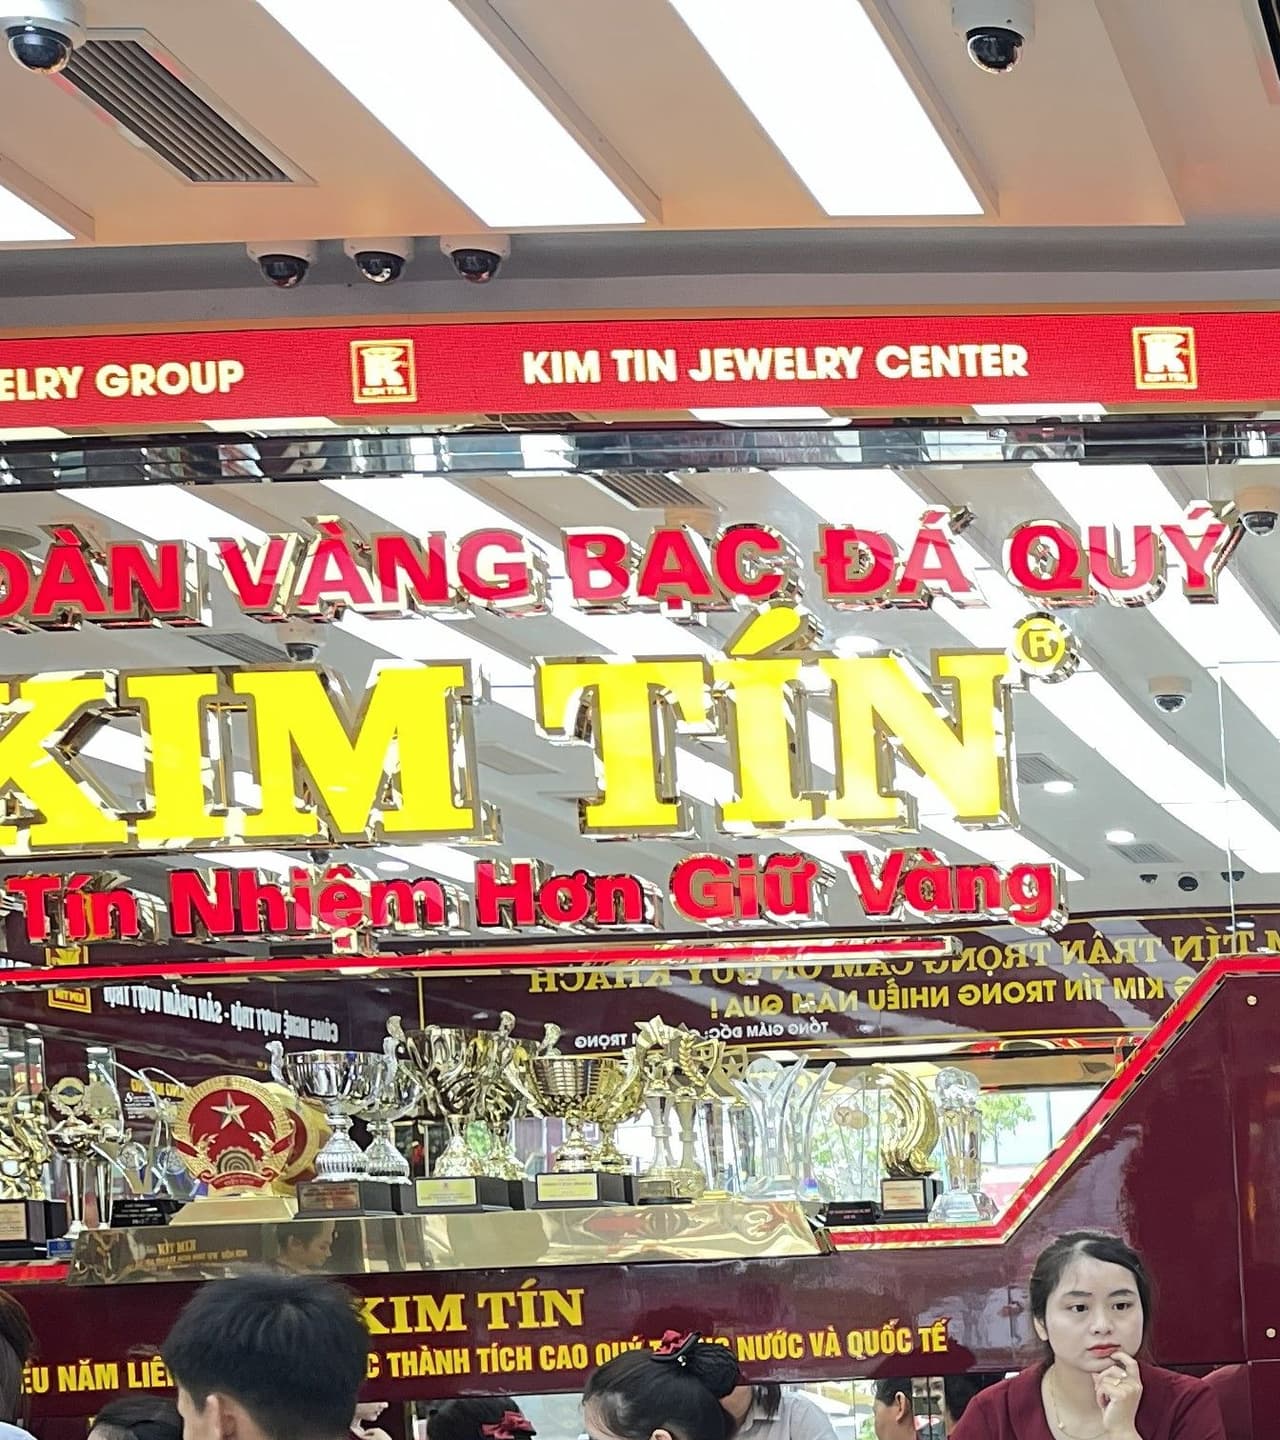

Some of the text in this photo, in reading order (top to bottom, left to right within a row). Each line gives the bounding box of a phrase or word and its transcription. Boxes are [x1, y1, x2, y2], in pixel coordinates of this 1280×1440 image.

[95, 360, 245, 398] GROUP
[523, 343, 1028, 385] KIM TIN JEWELRY CENTER
[216, 520, 531, 604] VÀNG
[568, 525, 787, 609] BẠC
[817, 511, 976, 594] ĐÁ
[1009, 508, 1226, 594] QUÝ
[0, 664, 477, 847] KIM
[538, 603, 1012, 835] TÍN
[8, 850, 1057, 953] Tín Nhiệm Hơn Giữ Vàng
[477, 1283, 585, 1330] TÍN
[57, 1358, 120, 1393] NĂM
[127, 1355, 177, 1389] LIÊ
[387, 1342, 470, 1376] THÀNH
[476, 1339, 532, 1375] TÍCH
[539, 1343, 589, 1370] CAO
[737, 1325, 803, 1360] NƯỚC
[810, 1325, 841, 1355] VÀ
[847, 1317, 913, 1355] QUỐC
[918, 1316, 951, 1353] TẾ
